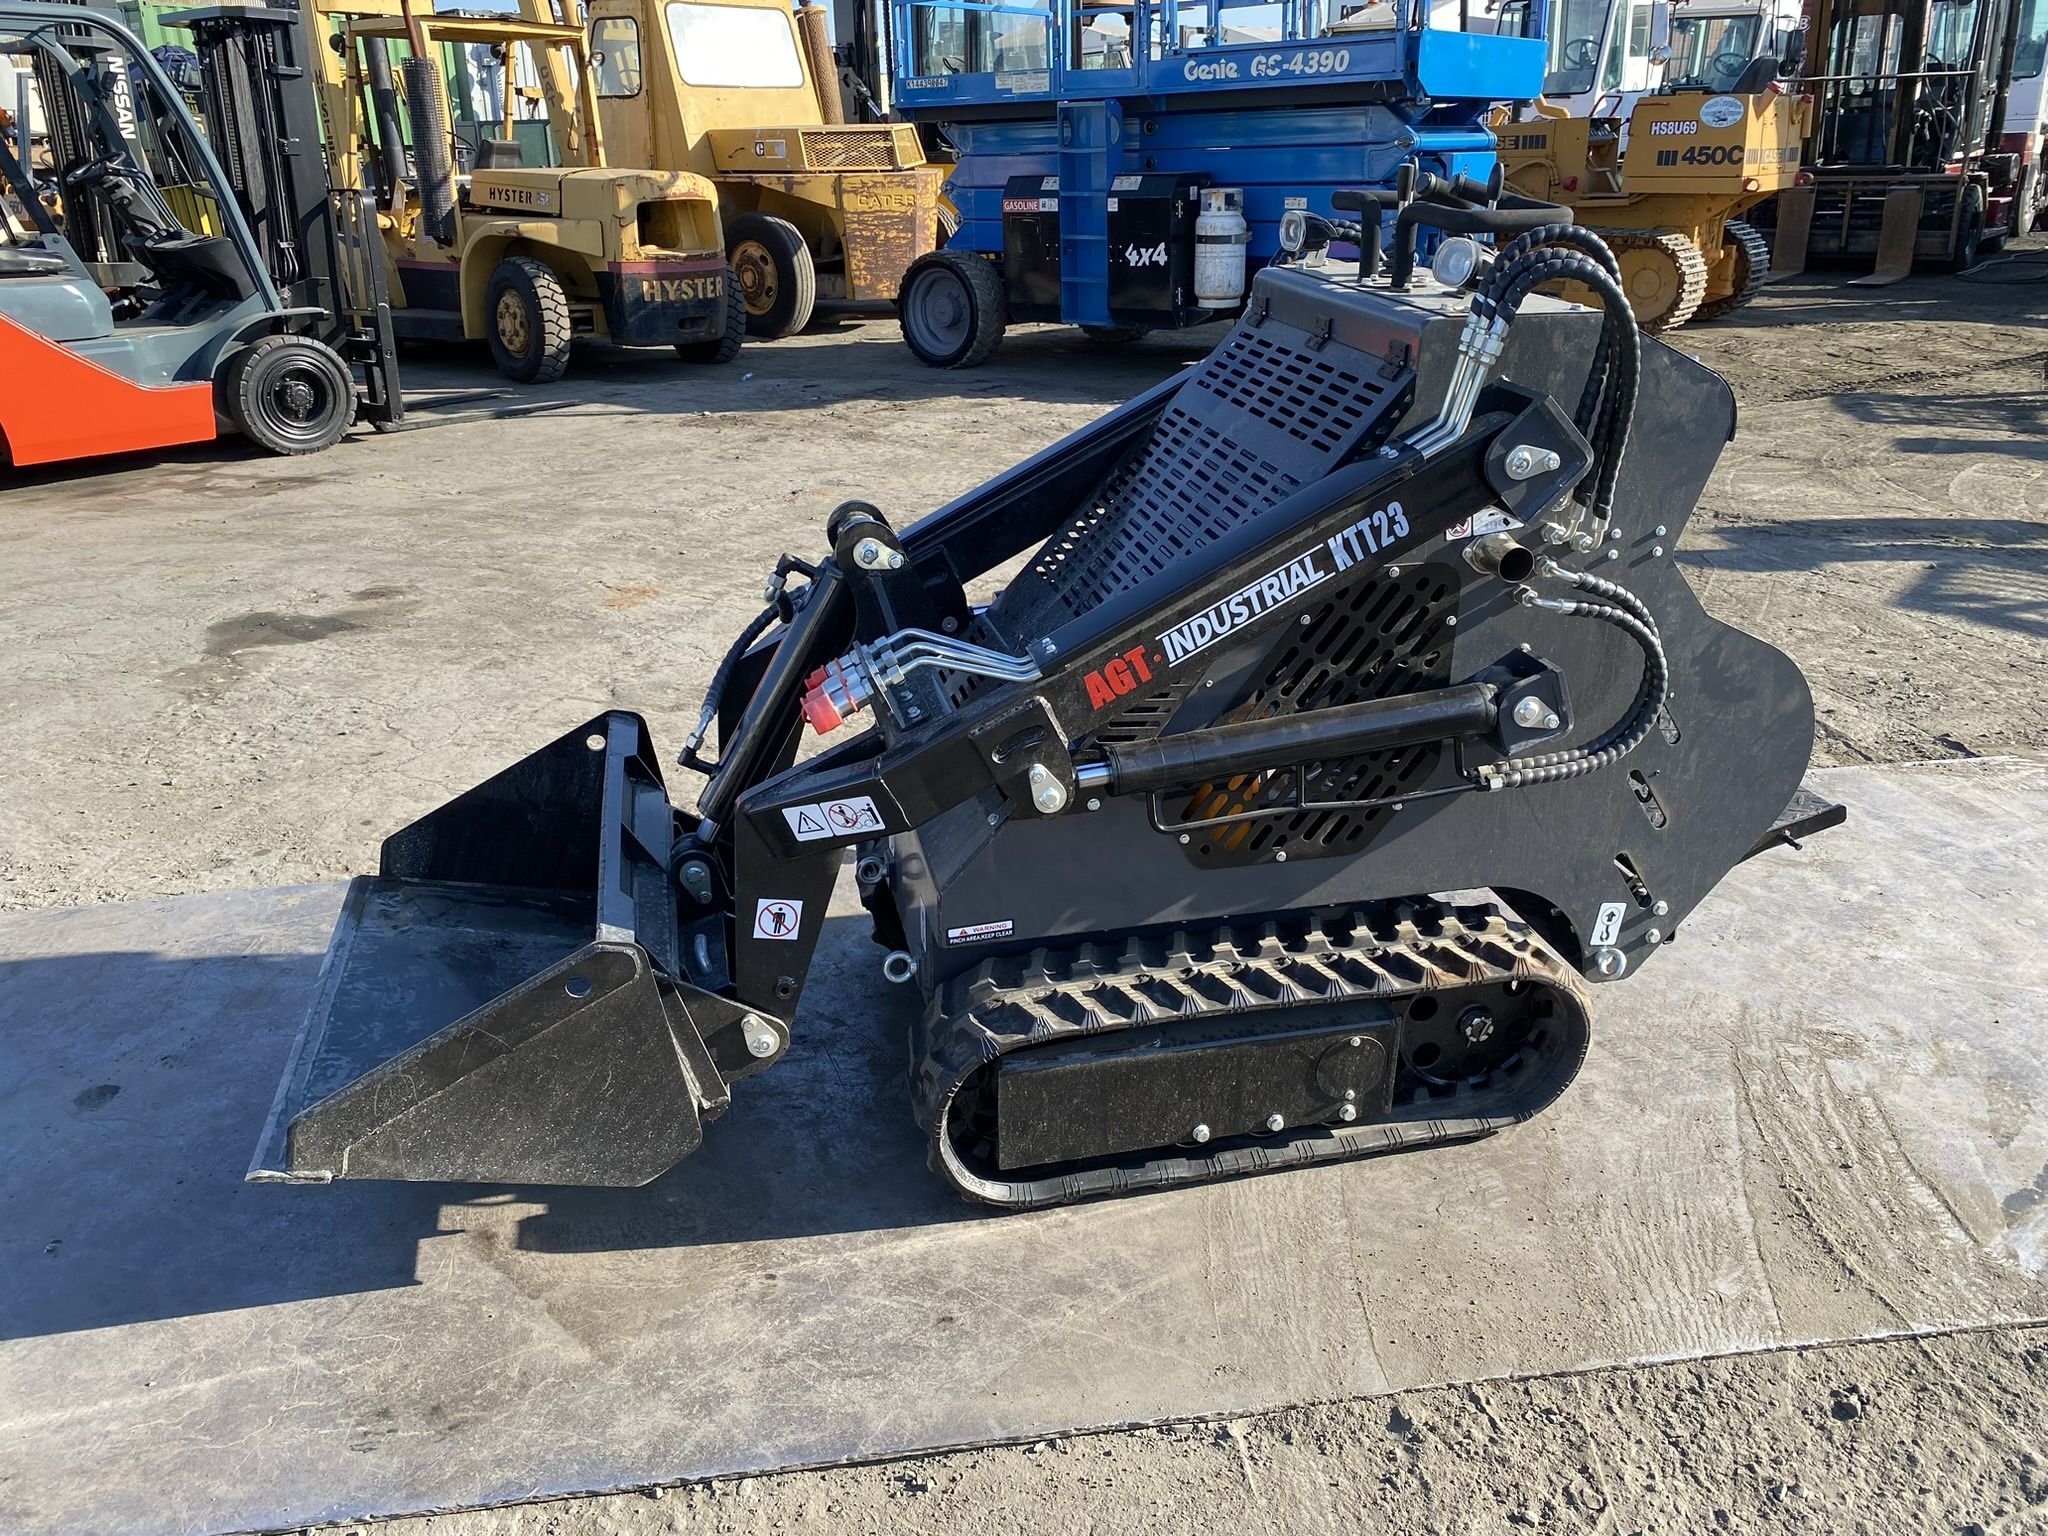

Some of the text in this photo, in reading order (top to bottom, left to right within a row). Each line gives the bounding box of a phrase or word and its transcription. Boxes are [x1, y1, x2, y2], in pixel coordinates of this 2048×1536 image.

[1184, 58, 1238, 81] Genie
[107, 56, 136, 139] NISSAN
[540, 65, 555, 109] CAT
[315, 69, 338, 167] HYSTER
[1650, 121, 1698, 135] HS8U69
[1681, 145, 1744, 165] 450C
[489, 187, 533, 204] HYSTER
[857, 194, 917, 208] CATER
[1004, 200, 1038, 211] GASOLINE
[1125, 242, 1168, 267] 4x4
[642, 275, 723, 302] HYSTER
[1084, 501, 1411, 710] AGT INDUSTRIAL KTT23
[972, 923, 1007, 933] WARNING
[996, 930, 1013, 938] CLEAR
